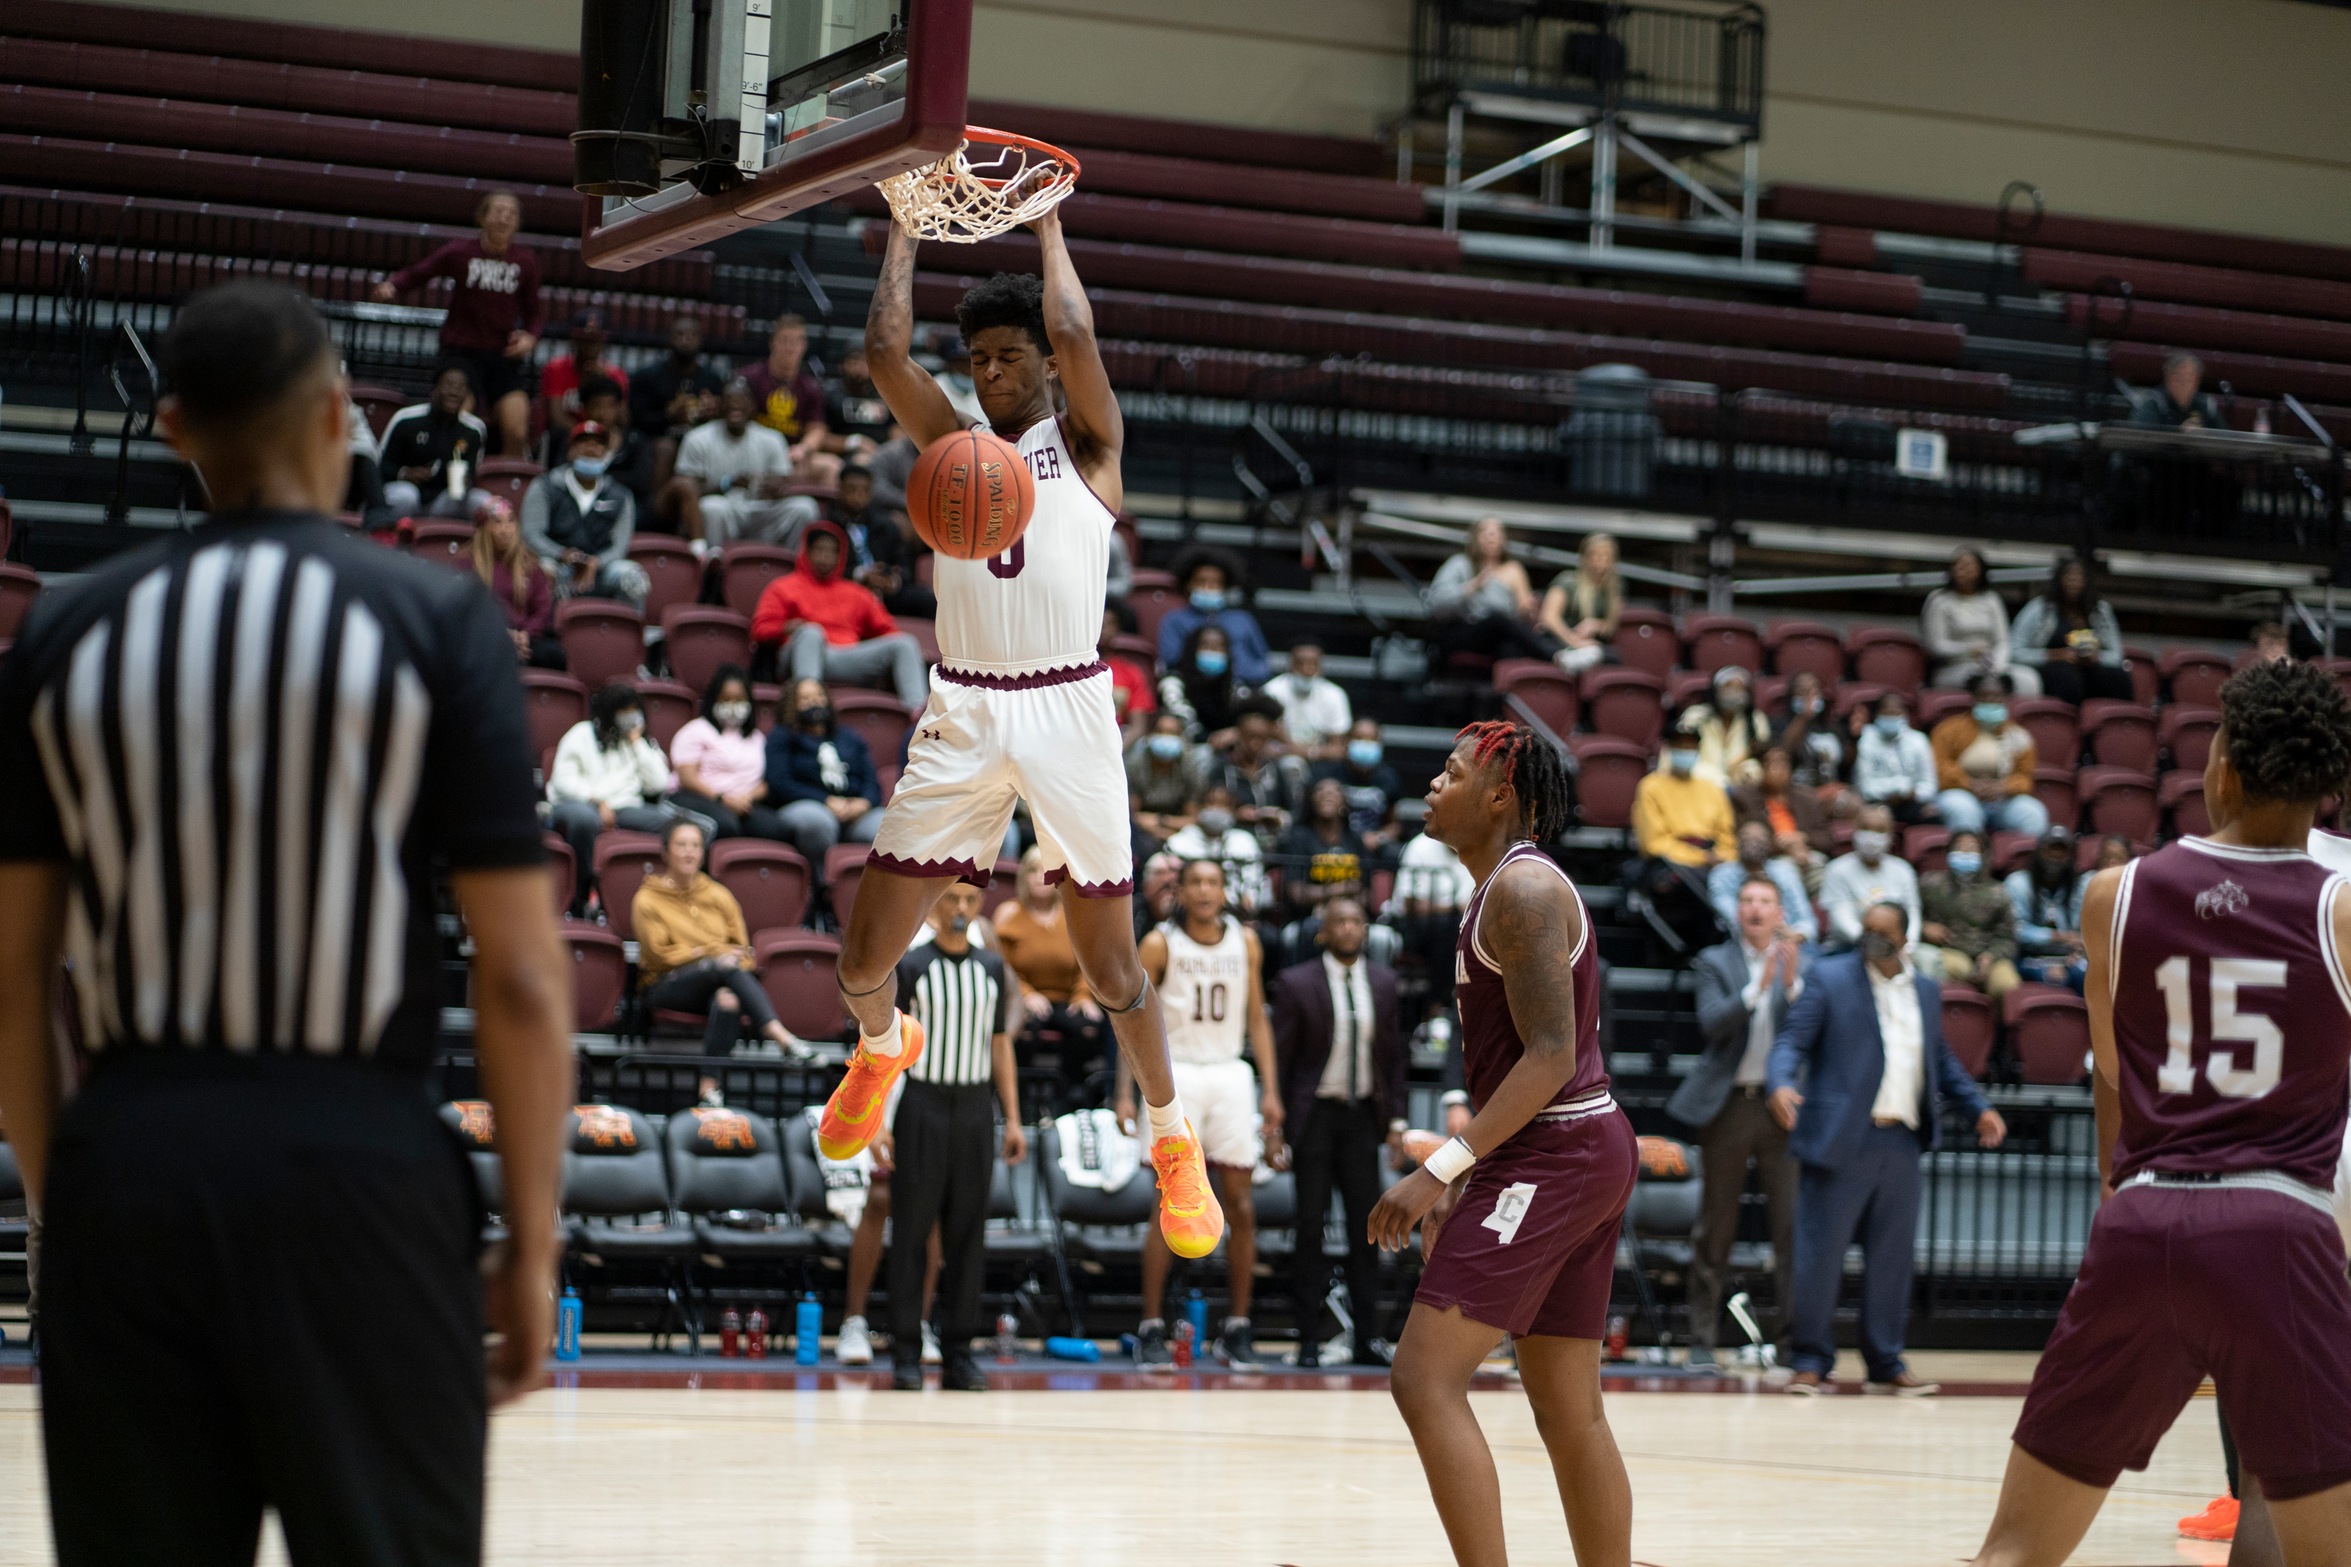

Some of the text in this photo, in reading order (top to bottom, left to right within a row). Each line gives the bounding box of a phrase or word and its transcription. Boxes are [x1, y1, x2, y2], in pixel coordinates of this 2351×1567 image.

[752, 3, 761, 13] 9'
[741, 160, 755, 170] 10'
[981, 461, 1003, 548] SPALDING
[1193, 983, 1226, 1022] 10
[2155, 956, 2288, 1099] 15
[1499, 1193, 1525, 1223] C
